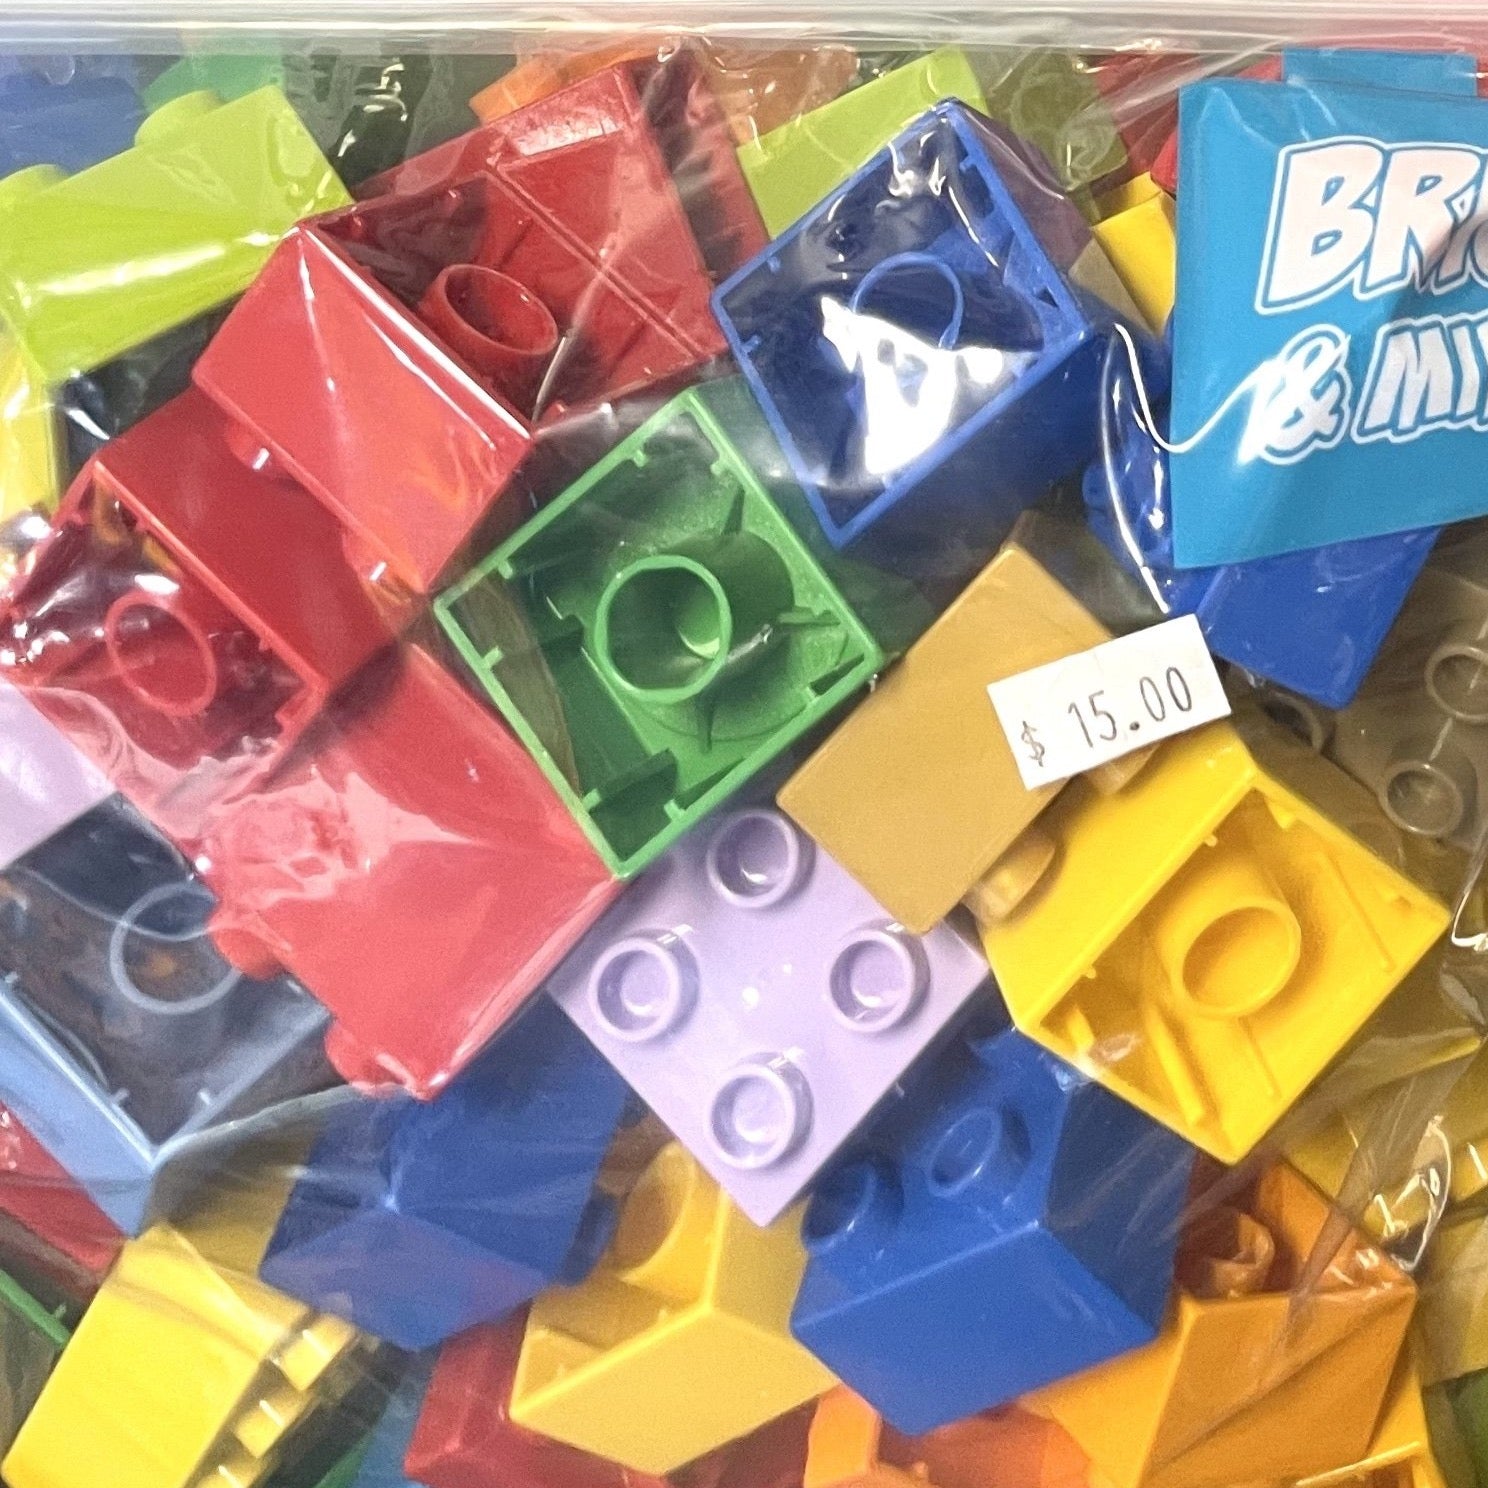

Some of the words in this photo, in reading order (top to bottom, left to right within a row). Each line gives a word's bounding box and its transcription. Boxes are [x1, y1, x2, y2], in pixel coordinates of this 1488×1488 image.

[1248, 323, 1354, 465] &
[1020, 719, 1046, 768] $
[1067, 666, 1193, 749] 15.00
